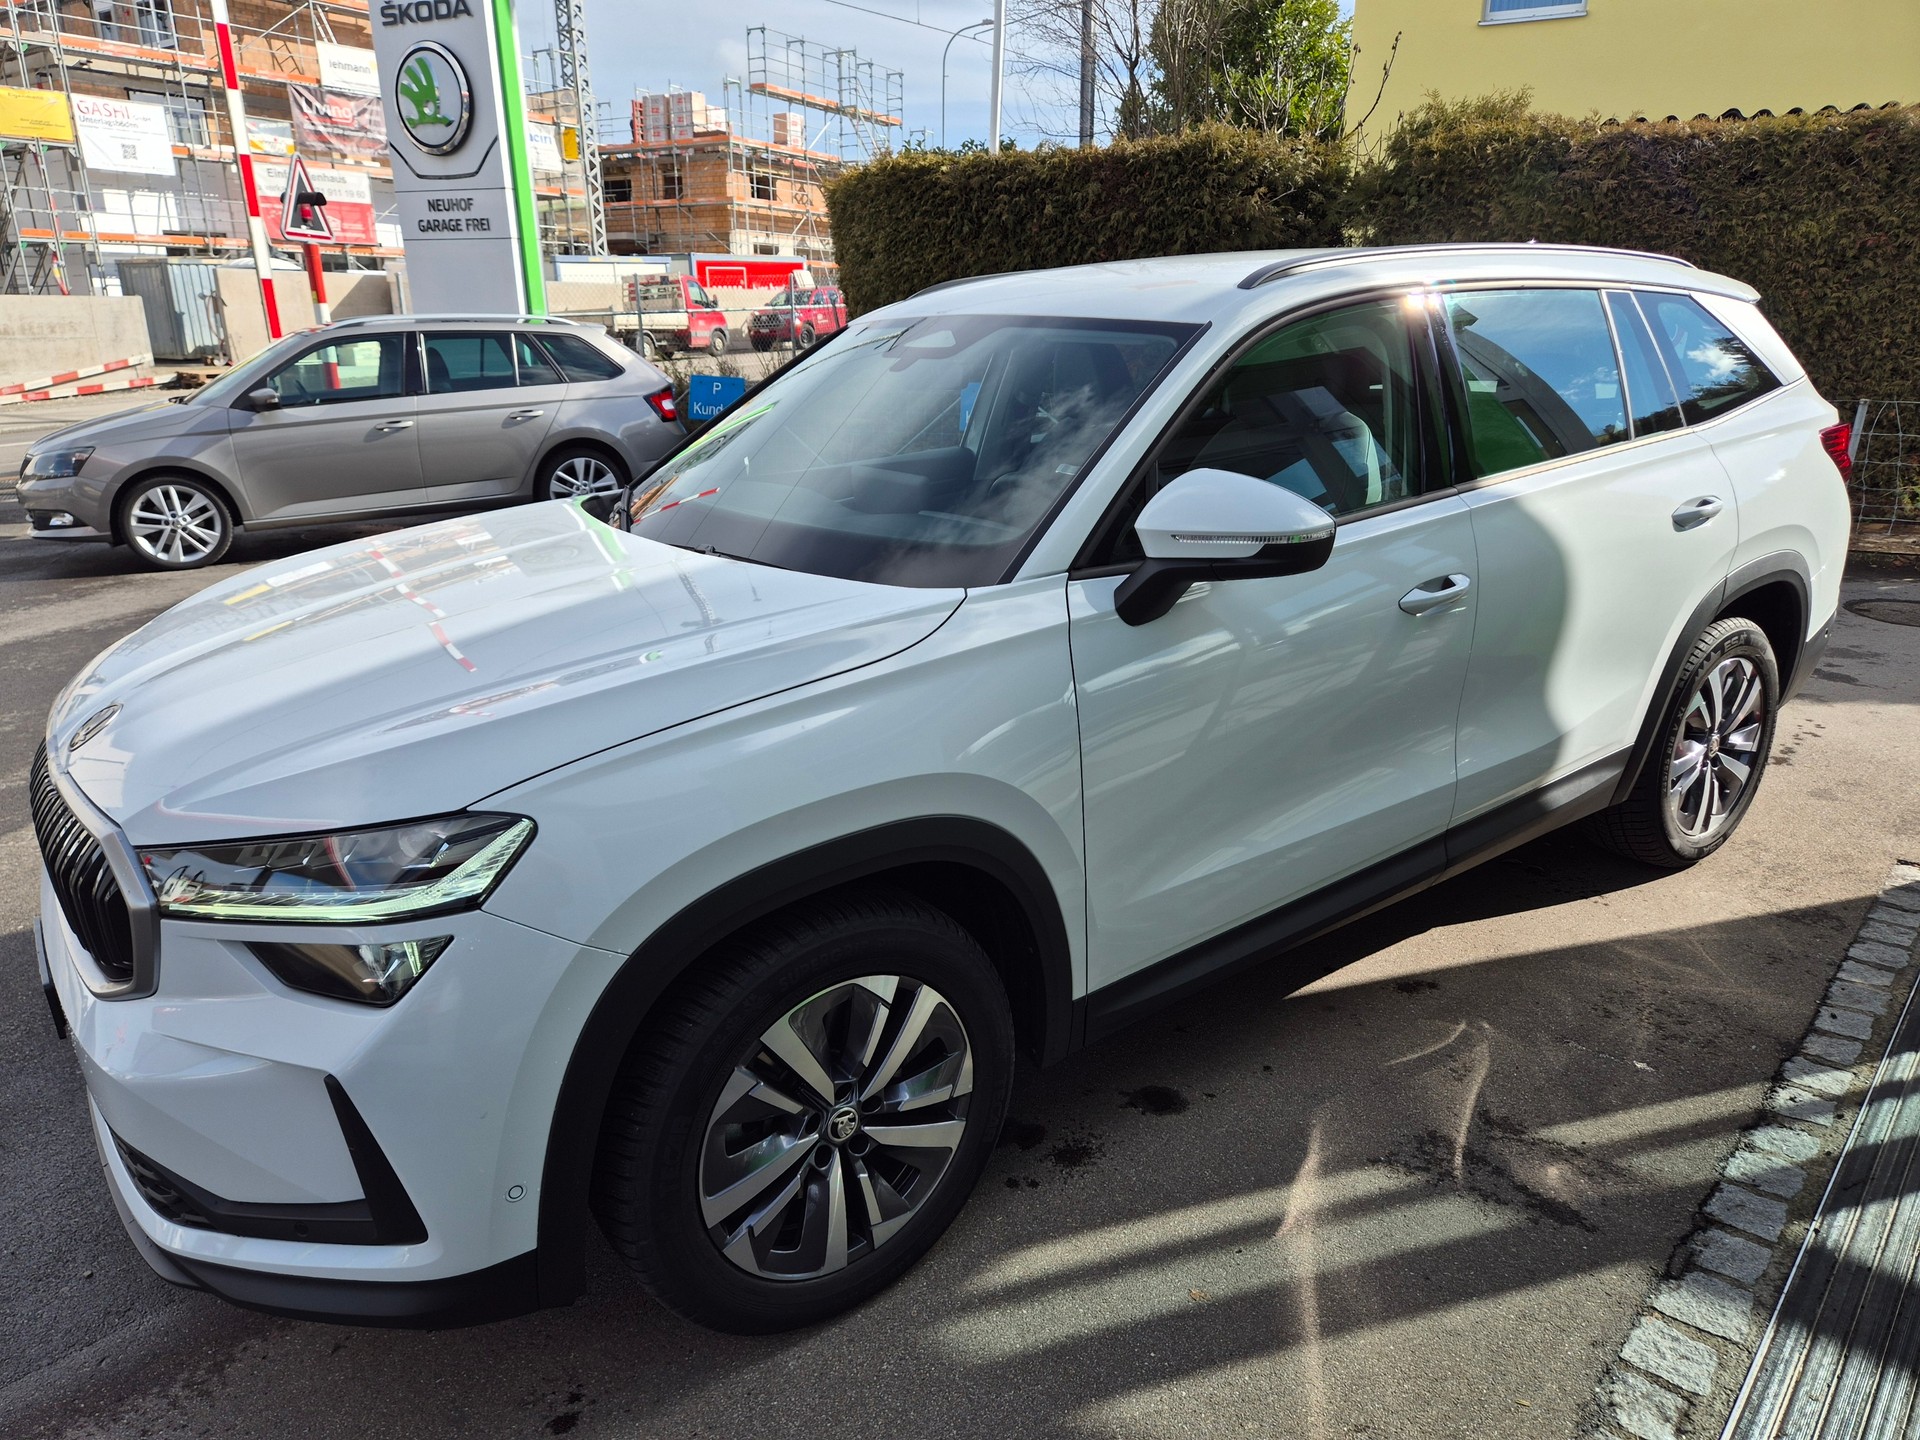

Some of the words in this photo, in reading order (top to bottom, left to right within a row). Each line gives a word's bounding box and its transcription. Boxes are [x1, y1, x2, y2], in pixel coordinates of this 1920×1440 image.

[380, 0, 474, 26] ŠKODA
[77, 100, 130, 119] GASHI
[427, 198, 474, 212] NEUHOF
[418, 219, 463, 232] GARAGE
[465, 218, 491, 232] FREI
[713, 382, 722, 395] P
